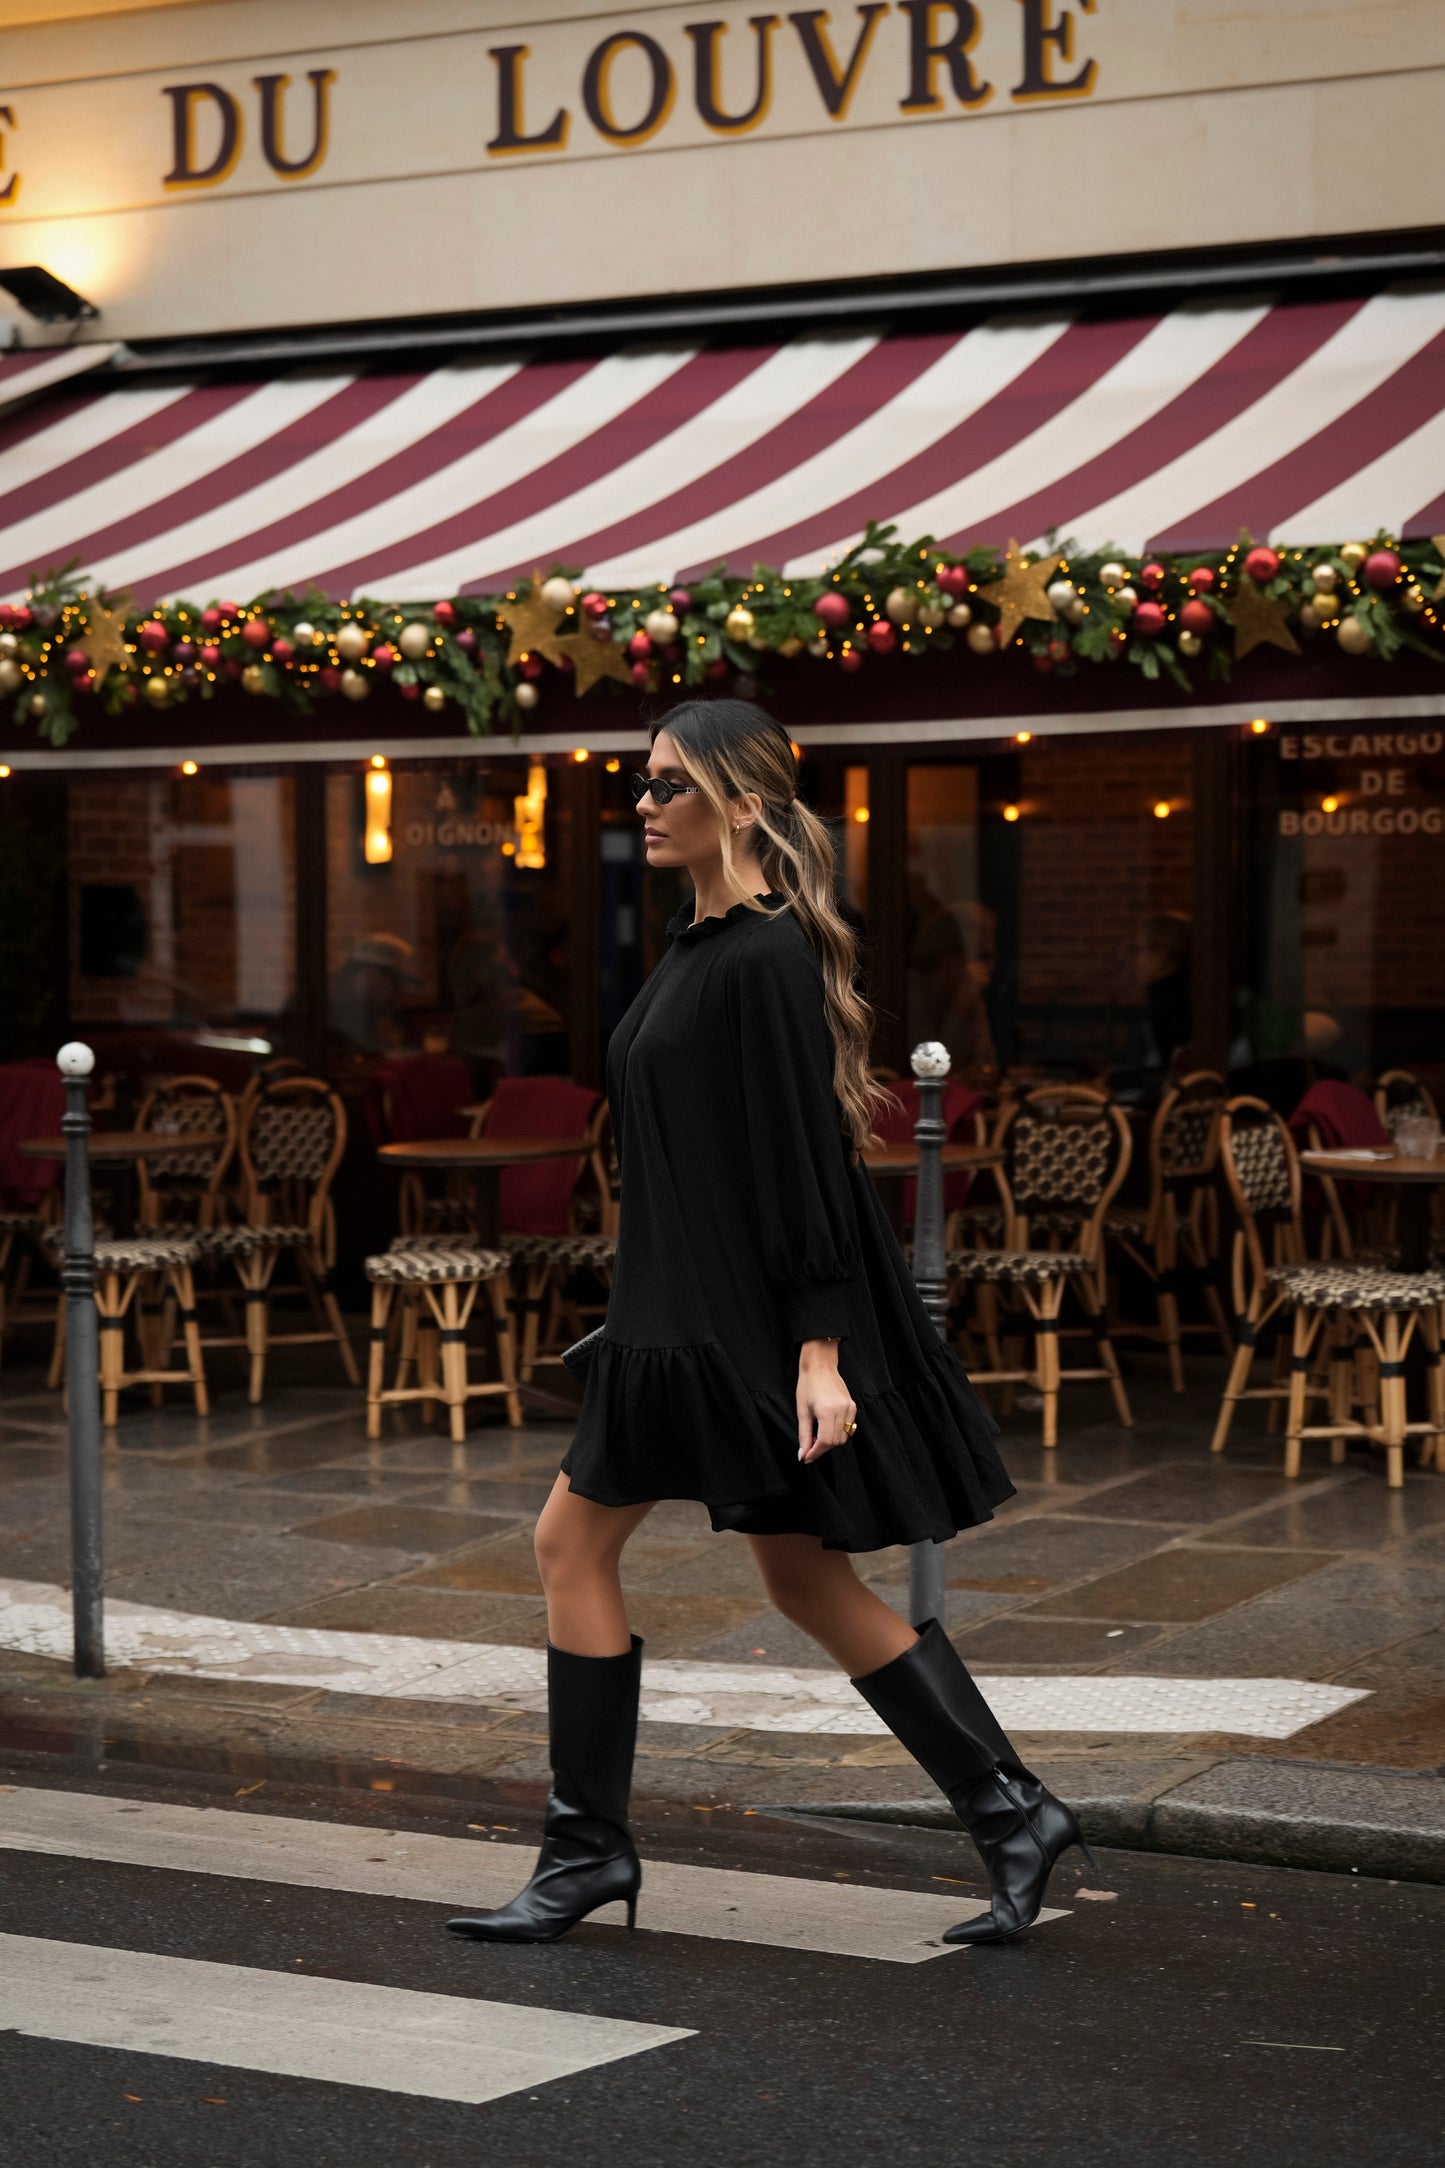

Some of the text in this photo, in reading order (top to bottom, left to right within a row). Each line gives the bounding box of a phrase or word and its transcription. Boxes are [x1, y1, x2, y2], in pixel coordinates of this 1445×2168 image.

[161, 69, 337, 191] DU
[487, 0, 1100, 157] LOUVRE
[1279, 731, 1444, 760] ESCARGO
[1359, 768, 1407, 797] DE
[1279, 806, 1445, 837] BOURGOG
